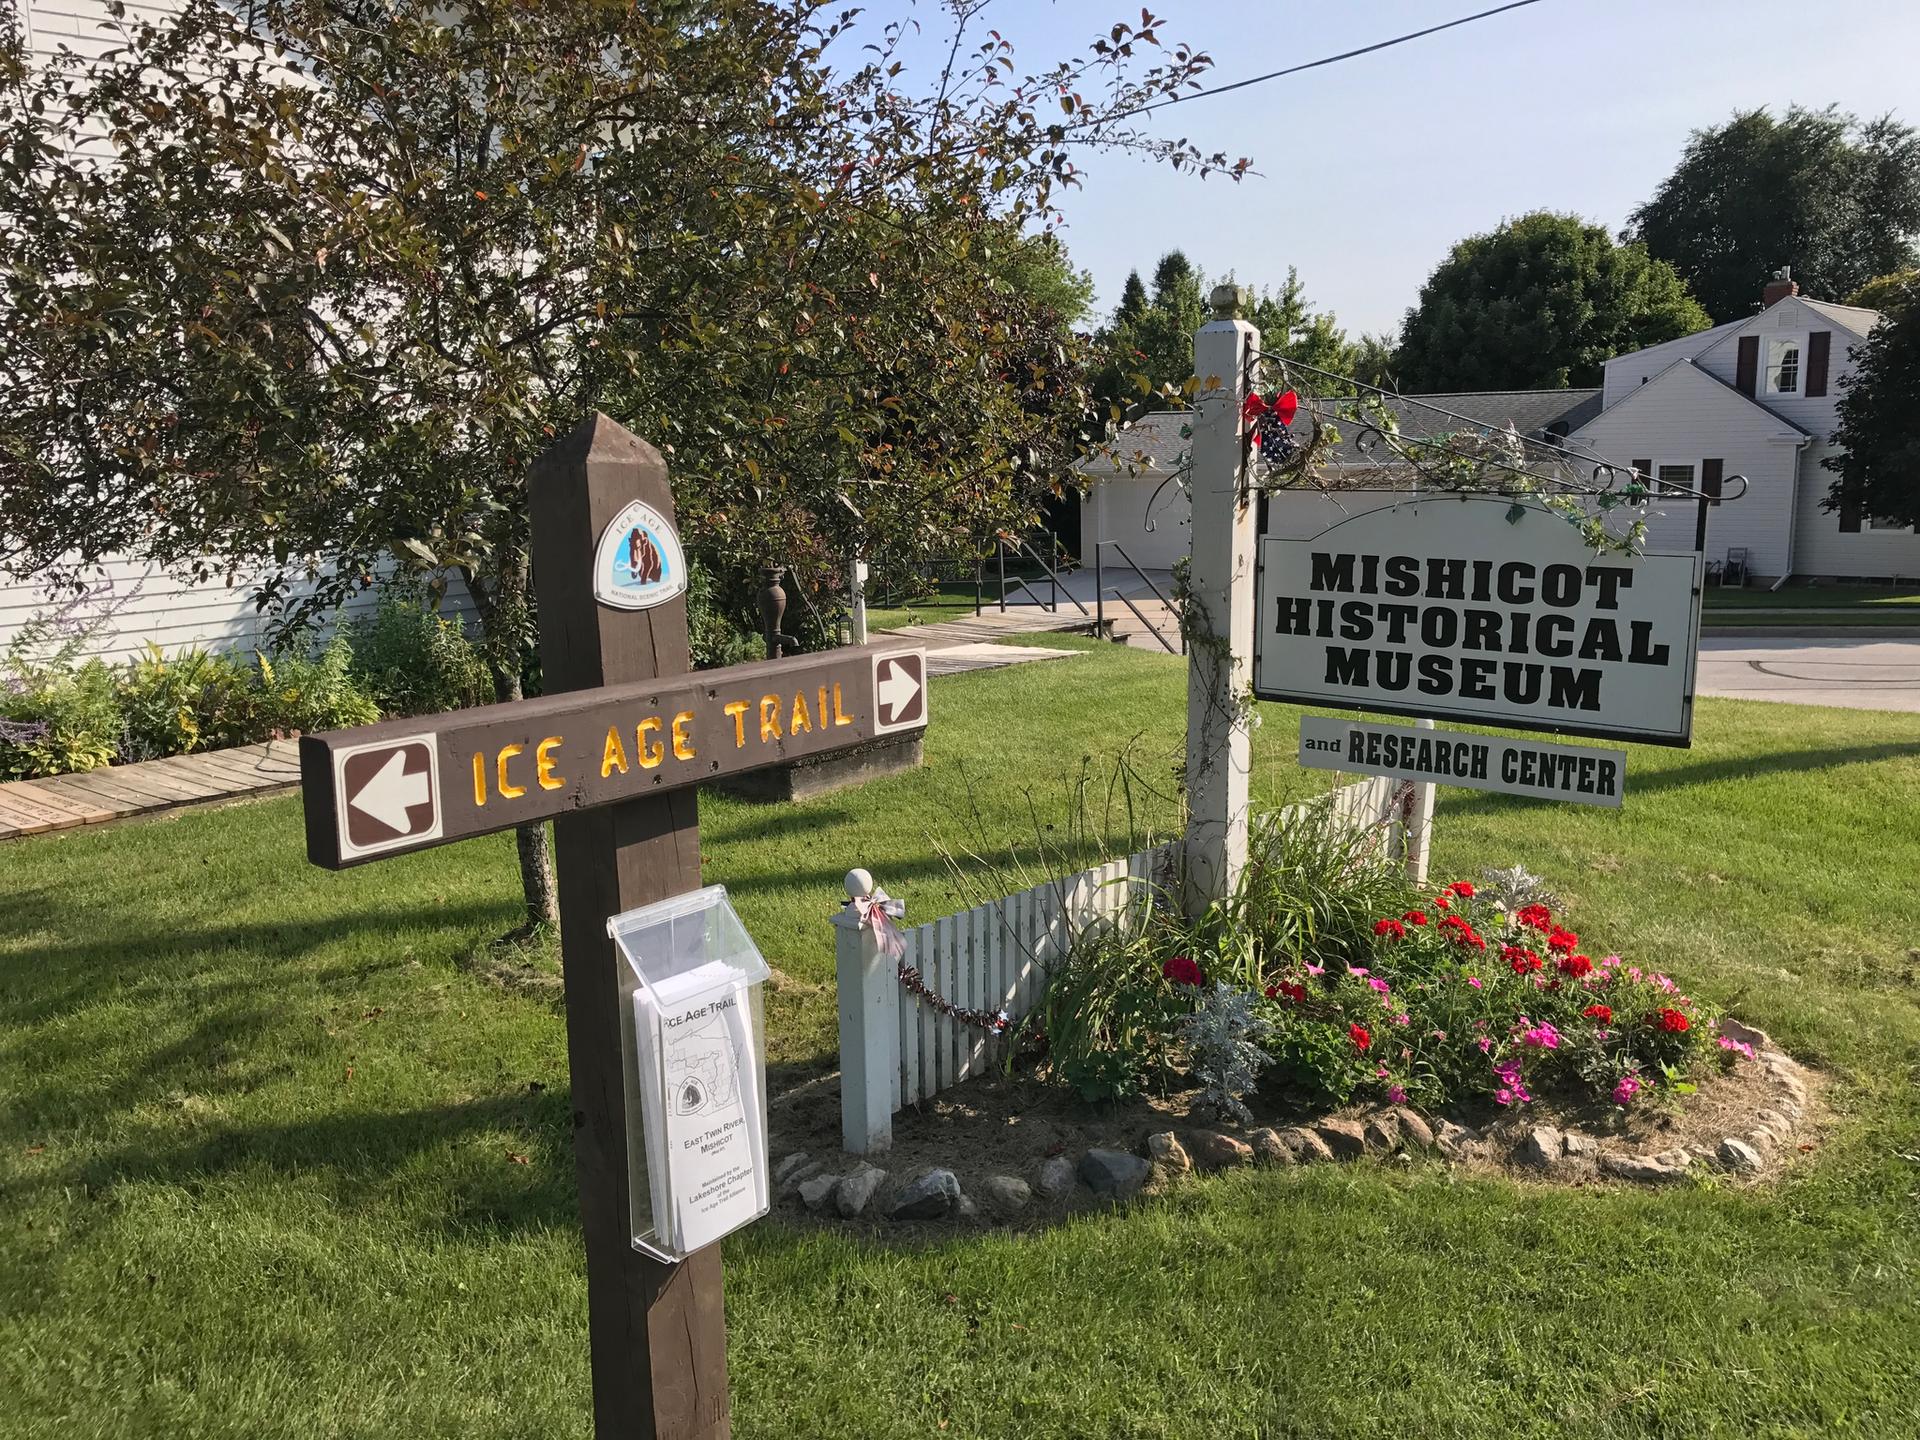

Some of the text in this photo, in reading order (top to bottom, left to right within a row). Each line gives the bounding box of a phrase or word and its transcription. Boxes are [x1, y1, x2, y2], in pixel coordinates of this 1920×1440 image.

[616, 514, 662, 535] ICE AGE
[611, 585, 674, 600] NATIONAL SCENIC TRAIL
[1310, 552, 1634, 610] MISHICOT
[1275, 597, 1670, 666] HISTORICAL
[1325, 646, 1603, 712] MUSEUM
[472, 682, 855, 807] ICE AGE TRAIL
[1305, 729, 1617, 797] and RESEARCH CENTER
[685, 1008, 707, 1023] AGE
[708, 998, 737, 1014] TRAIL
[684, 1117, 745, 1150] EAST TWIN RIVER
[700, 1133, 734, 1155] MISHICOT
[689, 1167, 752, 1204] Lakeshore Chapter
